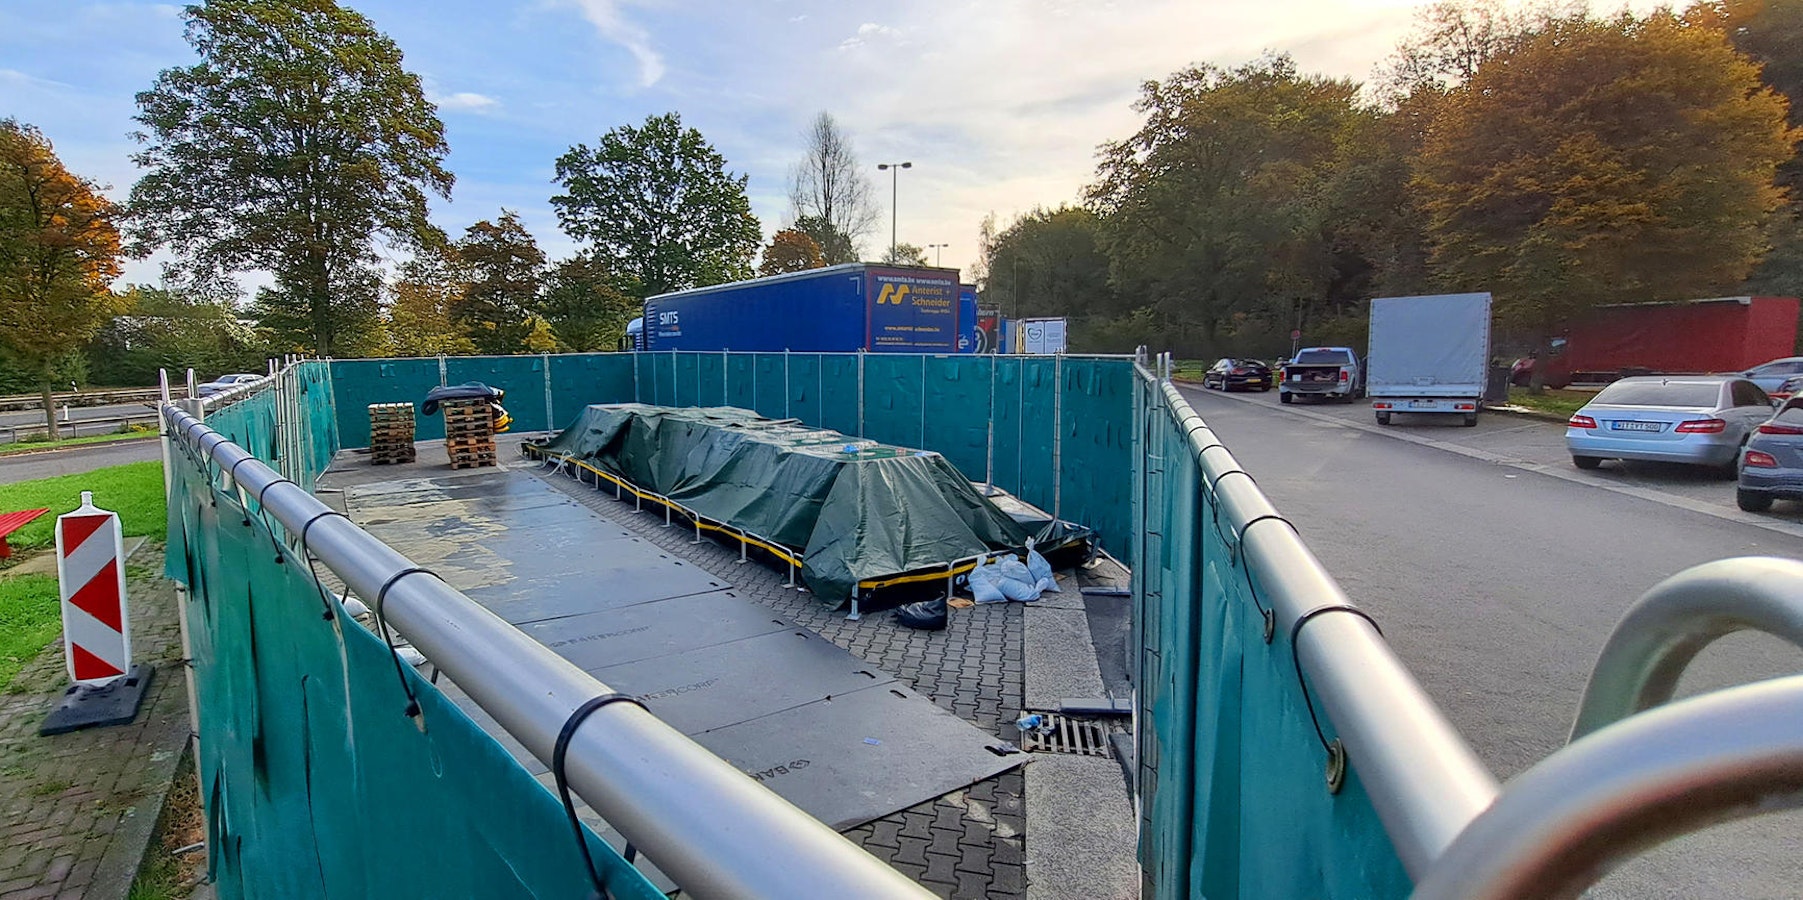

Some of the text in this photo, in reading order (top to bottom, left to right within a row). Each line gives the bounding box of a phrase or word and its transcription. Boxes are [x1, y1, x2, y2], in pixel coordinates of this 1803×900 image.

[912, 286, 943, 296] Anterist
[912, 296, 951, 307] Schneider
[660, 311, 678, 325] SMTS
